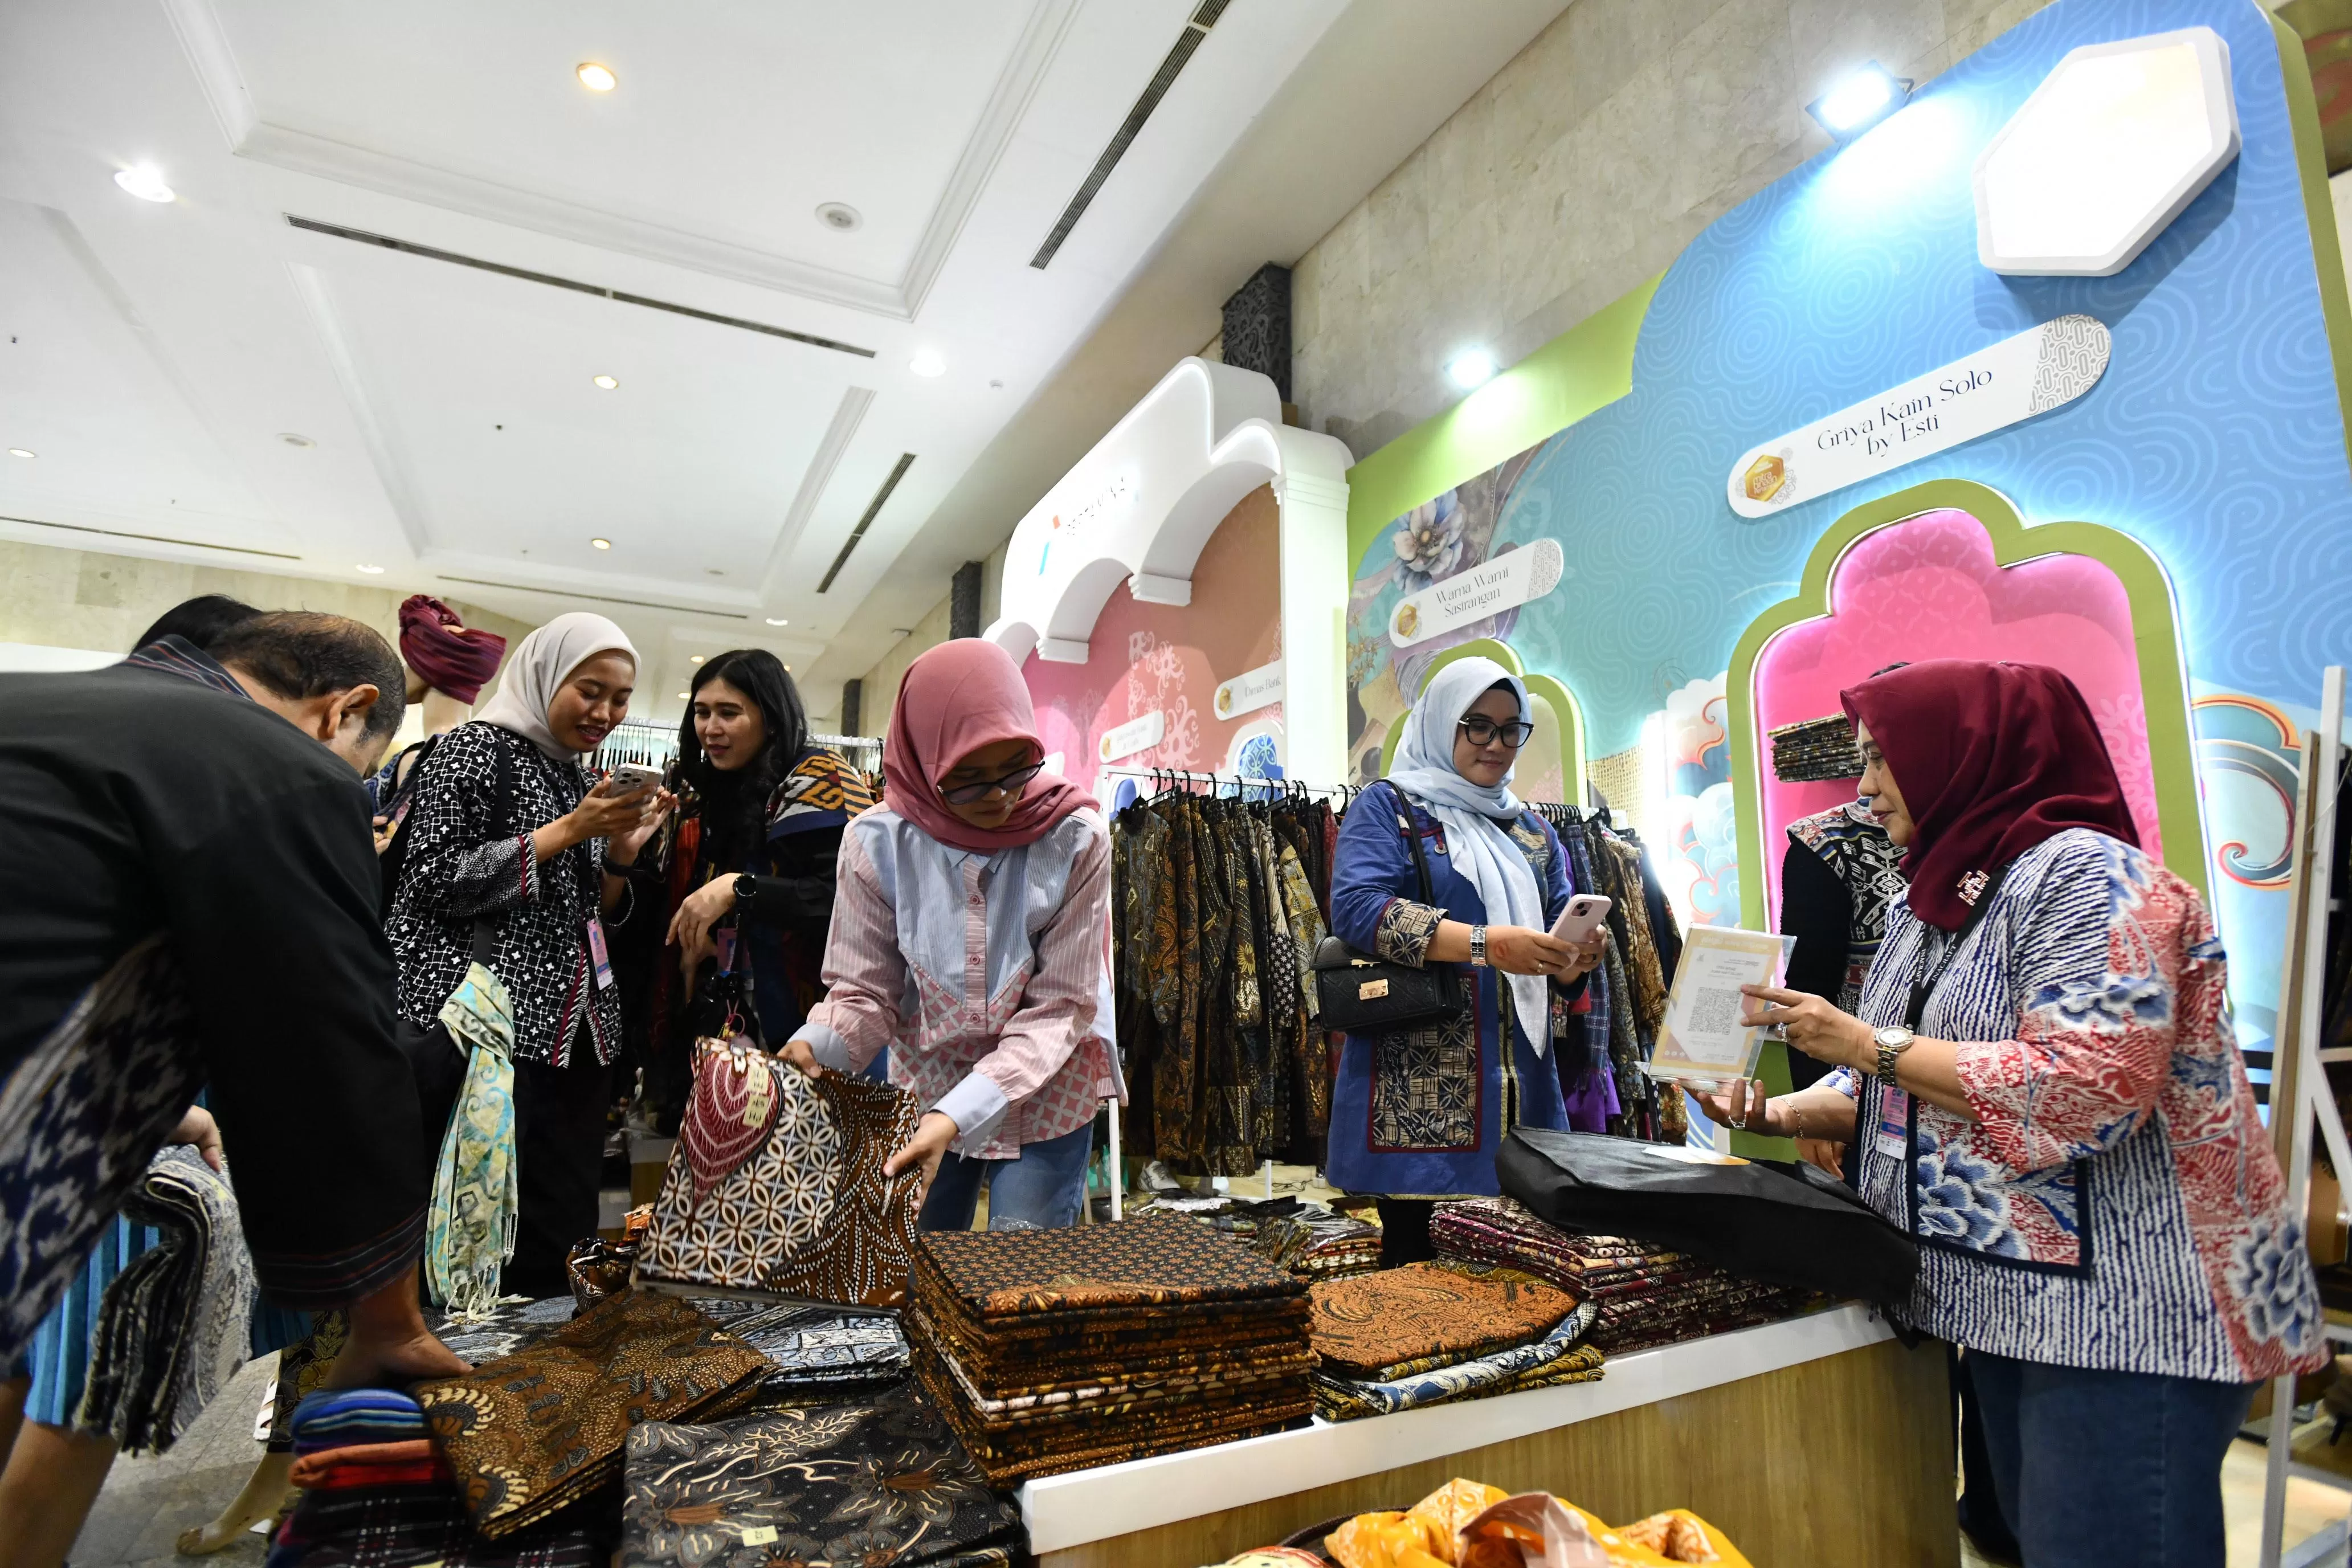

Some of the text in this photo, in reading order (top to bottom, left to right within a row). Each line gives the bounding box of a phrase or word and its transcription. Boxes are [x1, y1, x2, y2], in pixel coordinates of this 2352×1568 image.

[1817, 370, 1992, 450] Griya Kain Solo
[1867, 414, 1939, 458] by Esti
[1436, 566, 1509, 605] Warna Warni
[1445, 588, 1500, 618] Sasirangan
[1931, 944, 1957, 981] INACRAFT
